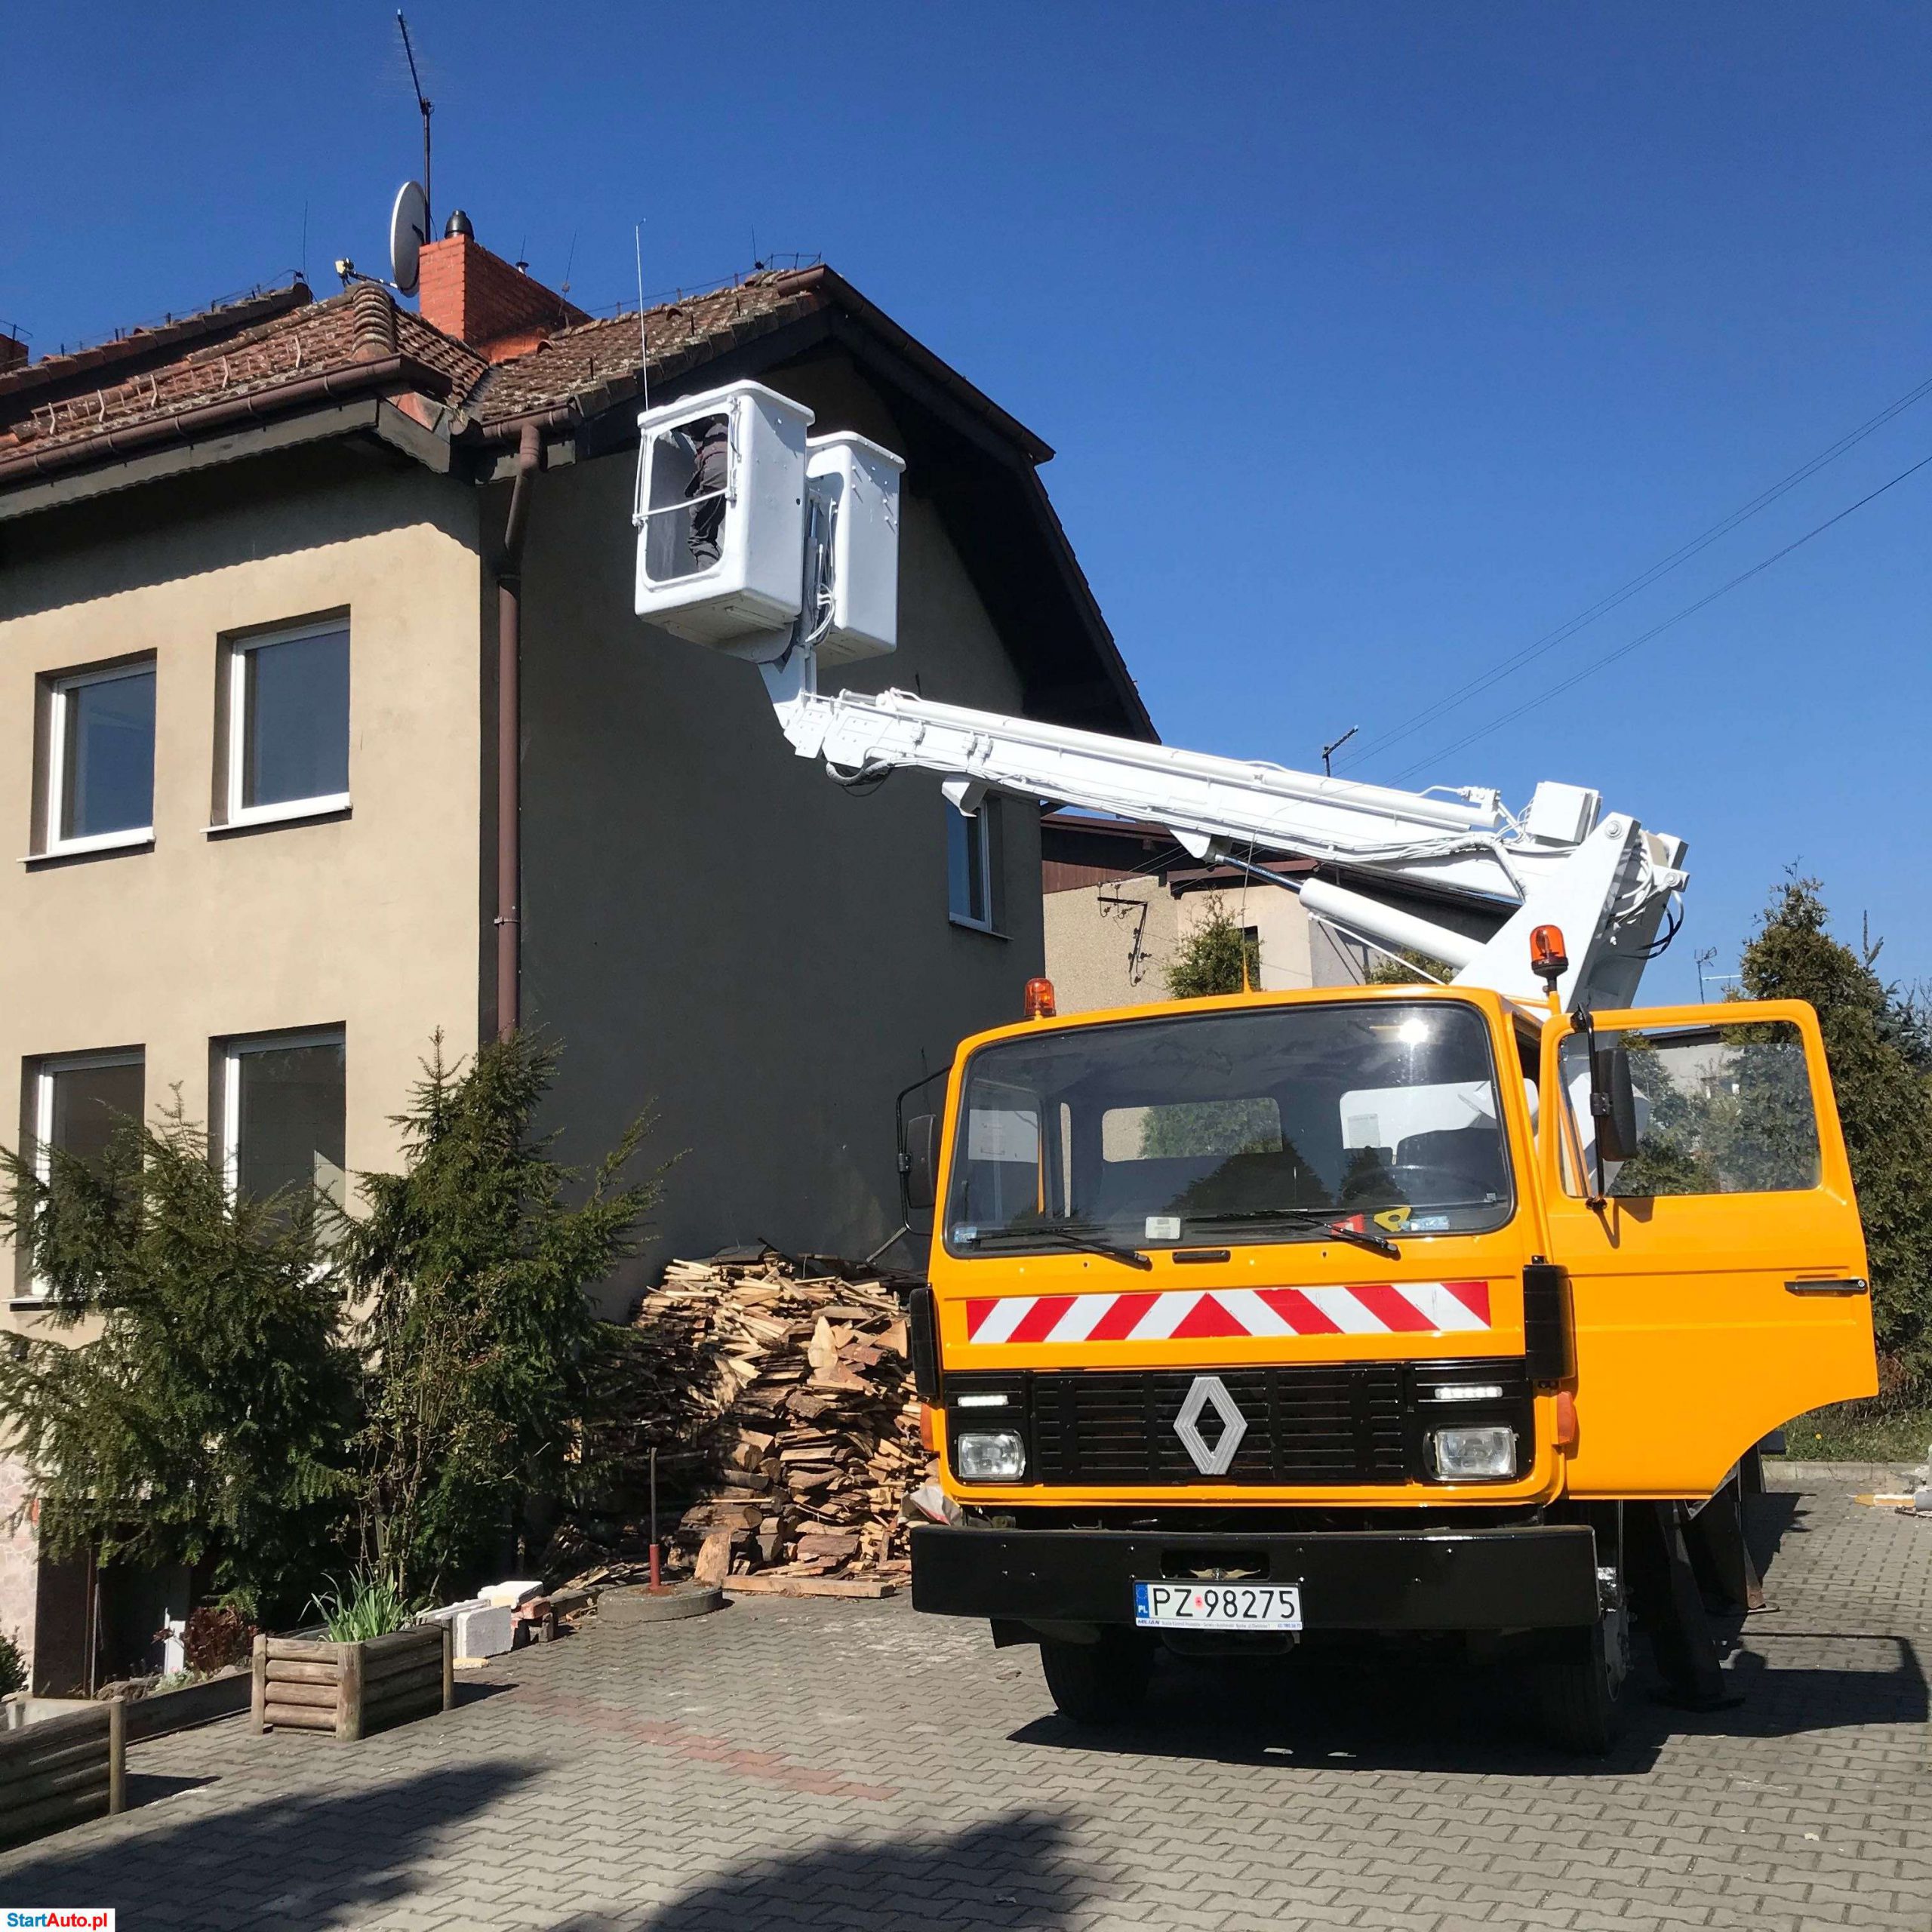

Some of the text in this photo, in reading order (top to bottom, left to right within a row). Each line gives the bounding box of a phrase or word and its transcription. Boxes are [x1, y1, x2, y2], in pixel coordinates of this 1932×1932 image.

[1138, 1604, 1148, 1614] PL
[1153, 1588, 1295, 1619] PZ 98275
